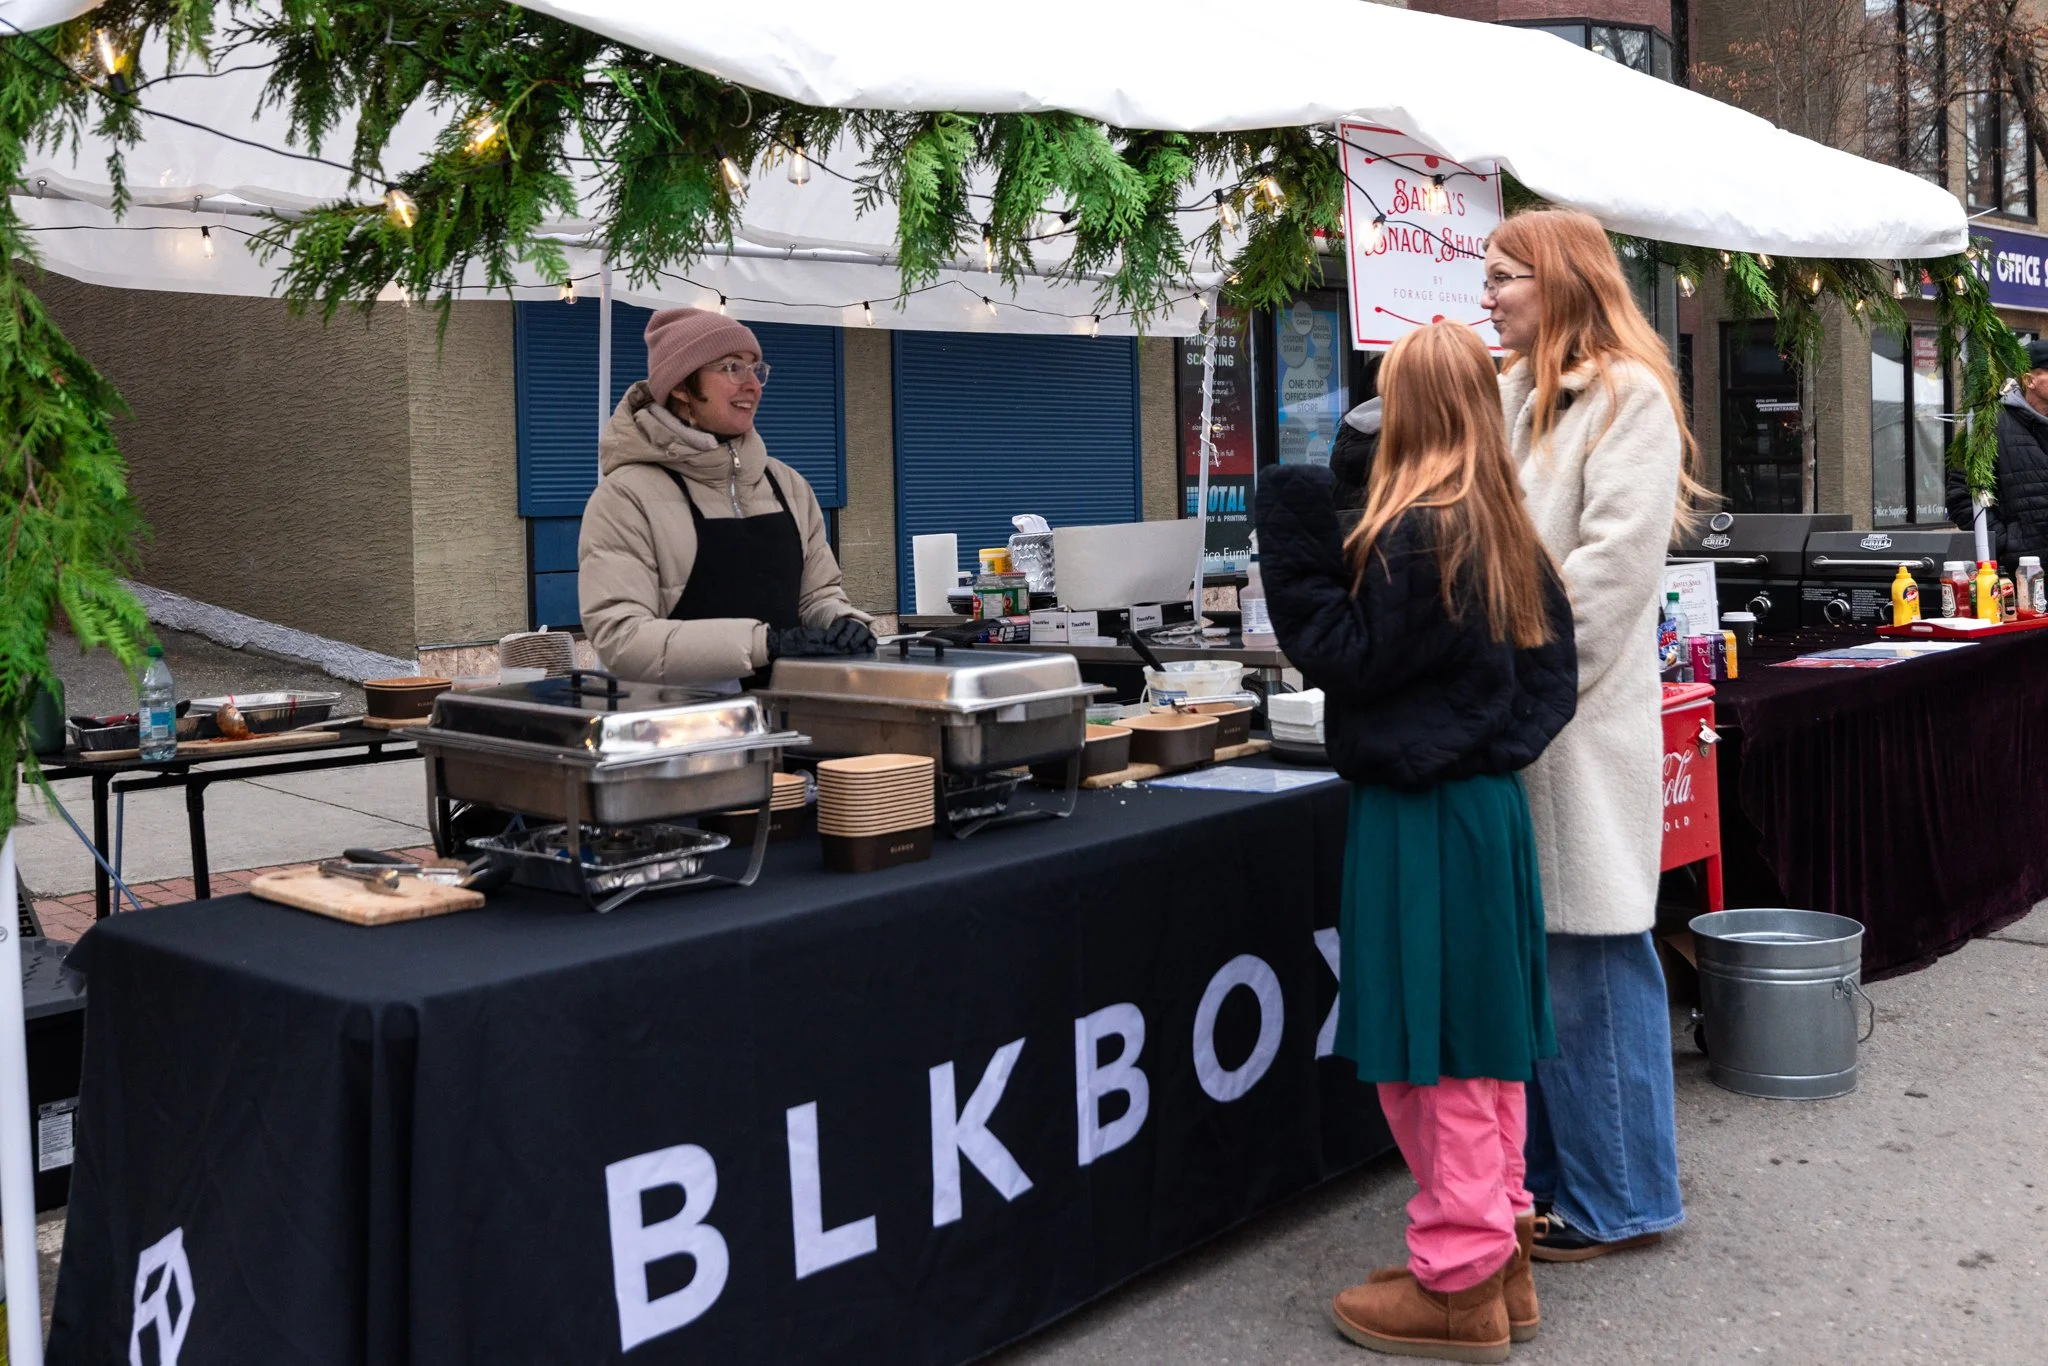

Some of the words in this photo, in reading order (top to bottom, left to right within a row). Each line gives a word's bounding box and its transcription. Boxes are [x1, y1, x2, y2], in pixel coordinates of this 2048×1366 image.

[1435, 227, 1486, 263] SHAC
[1996, 251, 2041, 286] OFFICE
[1433, 276, 1443, 285] BY
[1393, 288, 1433, 301] FORAGE
[1439, 292, 1482, 305] GENERAL
[1229, 336, 1237, 348] &
[1187, 353, 1235, 367] SCANING
[1288, 379, 1325, 389] ONE-STOP
[1284, 393, 1306, 401] OFFICE
[1297, 403, 1319, 413] STORE
[1206, 485, 1246, 513] OTAL
[1223, 514, 1247, 522] PRINTING
[1223, 546, 1252, 562] Furnit
[1136, 614, 1156, 622] TouchFlex
[1662, 749, 1692, 807] ola
[1664, 815, 1690, 832] OLD
